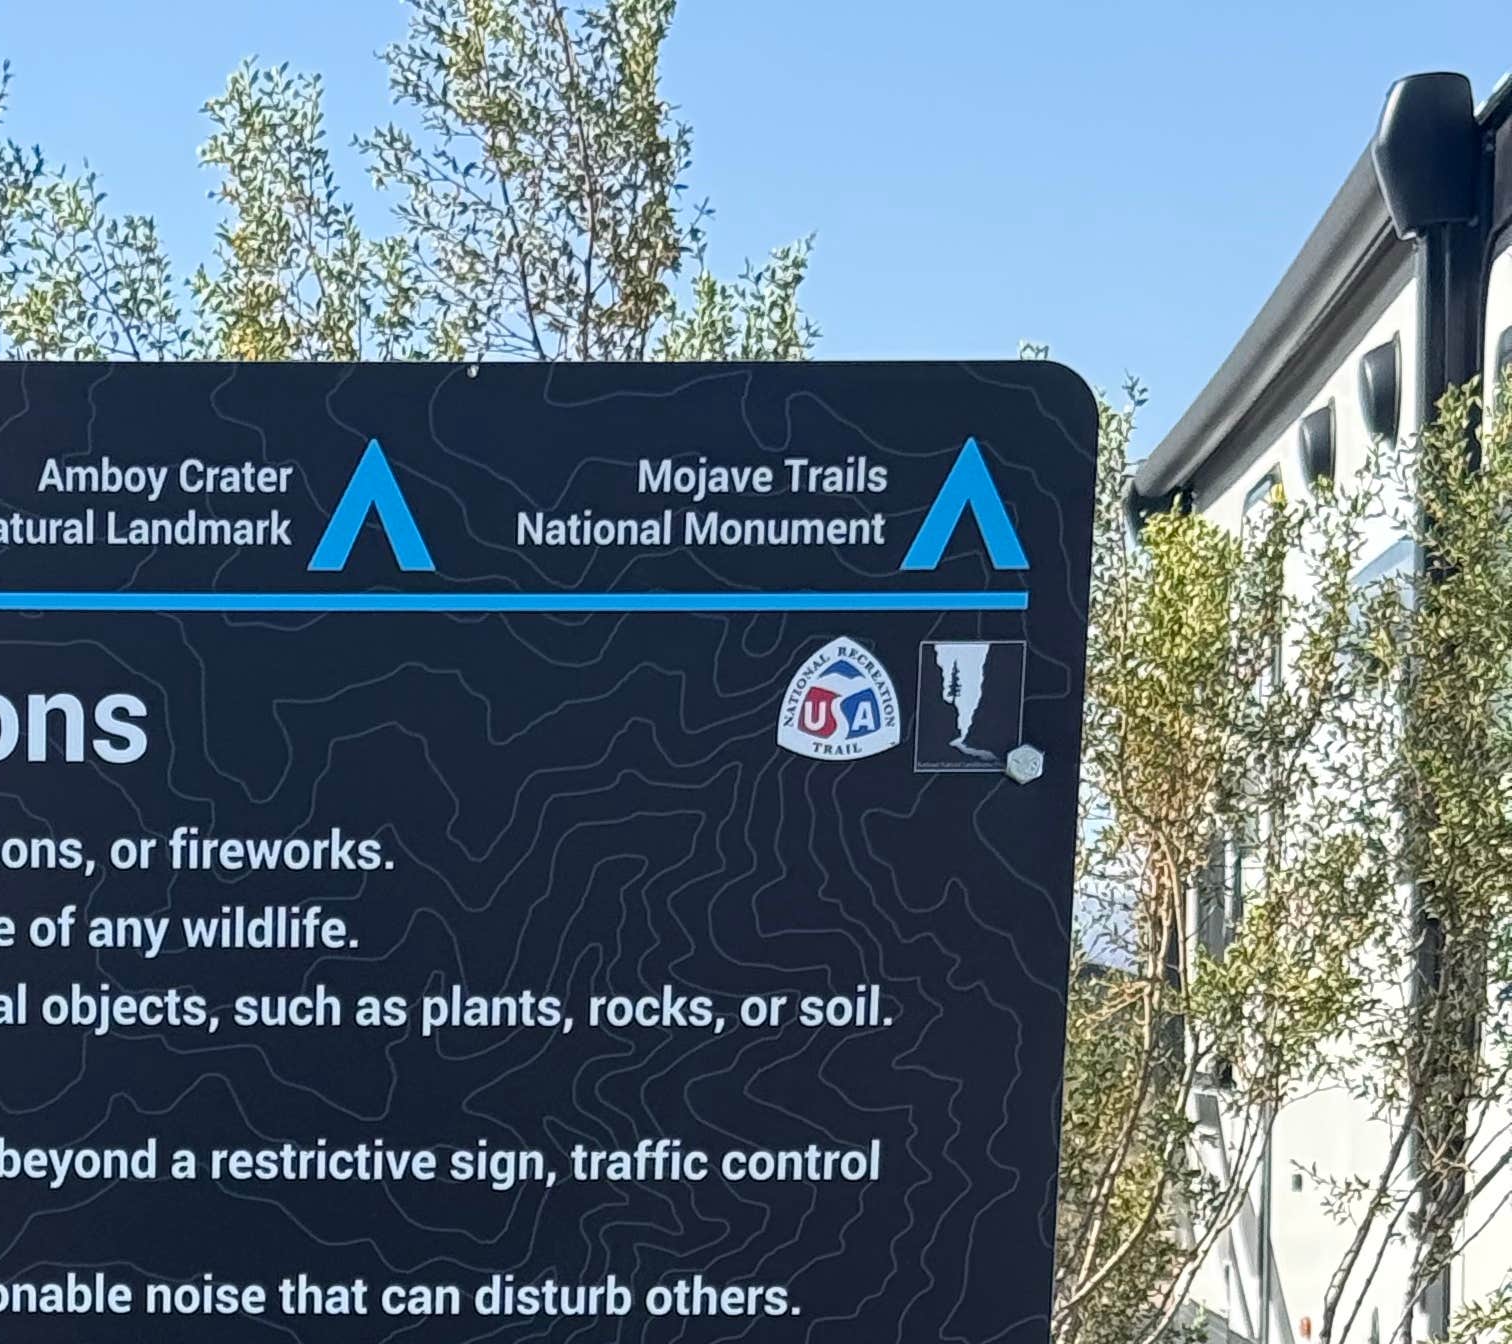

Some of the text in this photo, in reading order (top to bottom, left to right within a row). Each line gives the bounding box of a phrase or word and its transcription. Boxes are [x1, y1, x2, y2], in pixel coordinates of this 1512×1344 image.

[37, 456, 294, 502] Amboy Crater
[638, 455, 888, 502] Mojave Trails
[107, 509, 292, 546] Landmark
[517, 509, 886, 546] National Monument
[783, 645, 896, 728] NATIONAL RECREATION
[800, 692, 879, 739] USA
[812, 741, 863, 755] TRAIL
[110, 838, 157, 870] or
[168, 825, 394, 871] fireworks.
